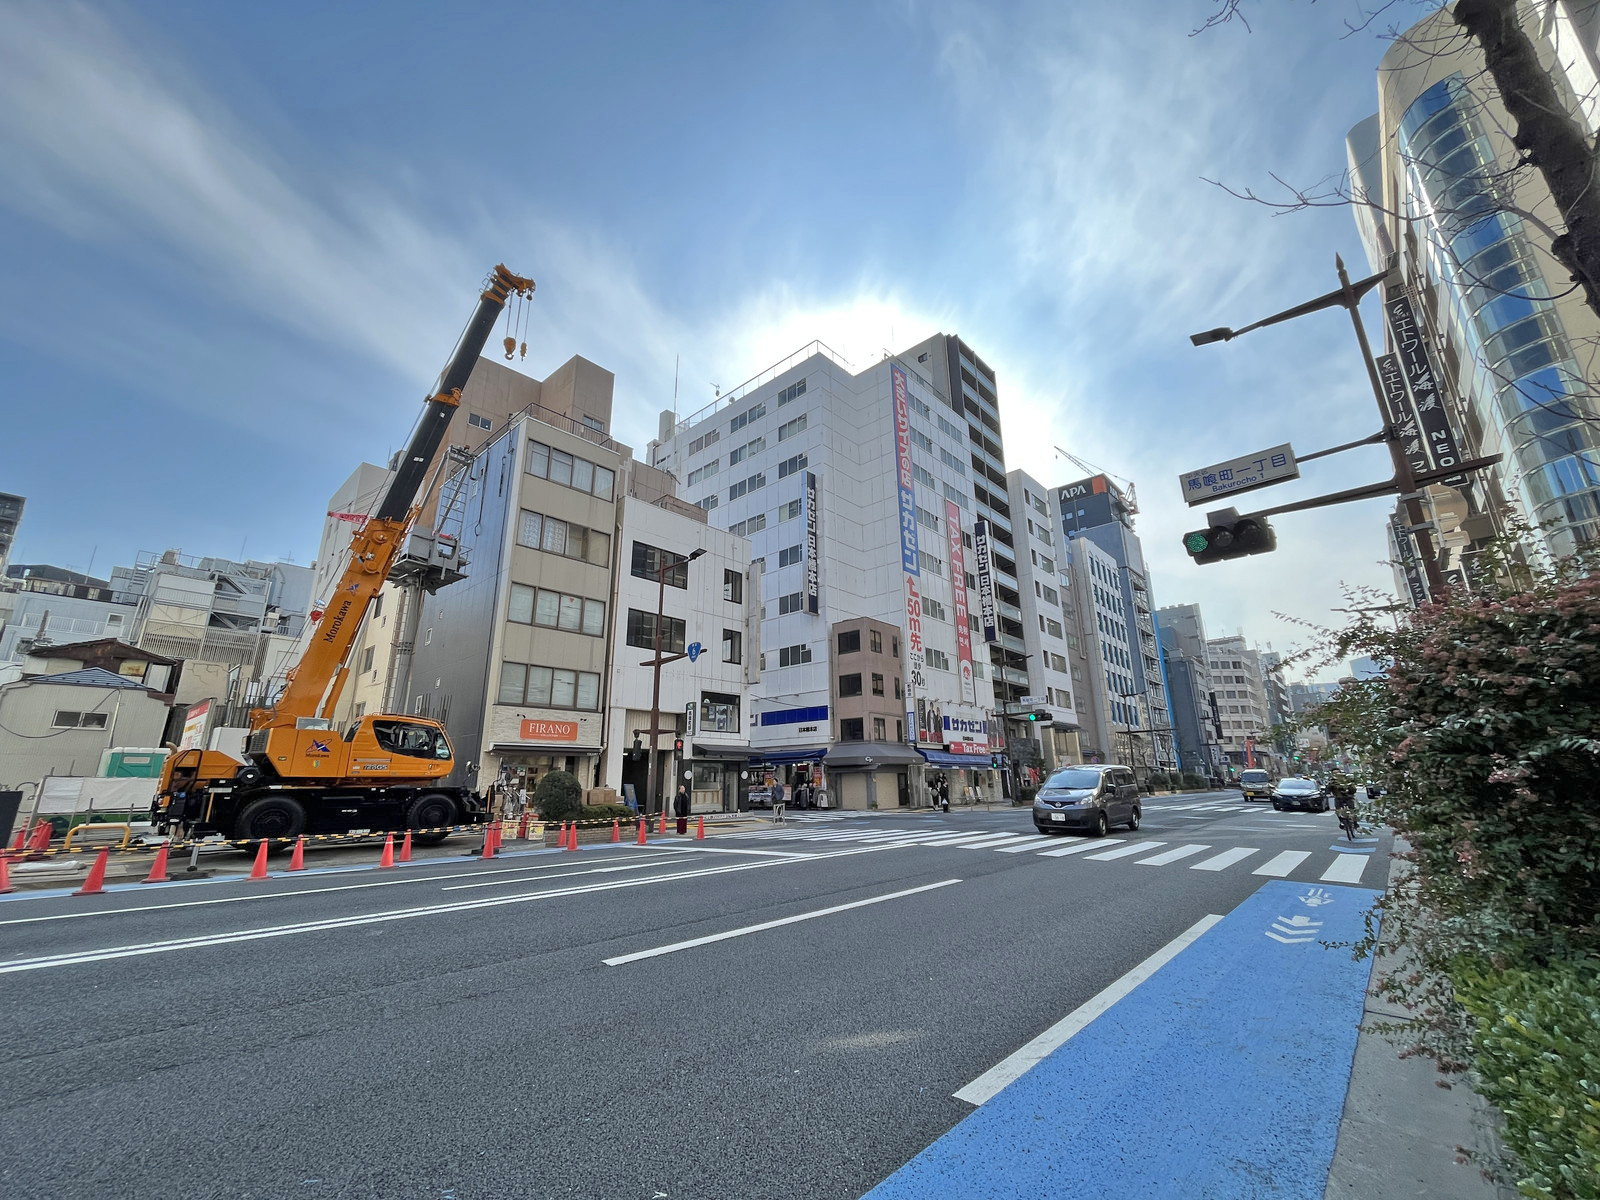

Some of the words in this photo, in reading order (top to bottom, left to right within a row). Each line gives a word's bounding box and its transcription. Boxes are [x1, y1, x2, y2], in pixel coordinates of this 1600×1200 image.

[1394, 318, 1441, 412] エトワール海渡
[1385, 371, 1425, 455] エトワール海渡
[1187, 453, 1287, 491] 馬喰町一丁目
[1212, 475, 1257, 493] Bakurocho
[1061, 484, 1087, 500] APA
[901, 490, 918, 572] サカゼン
[949, 516, 962, 557] TAX
[953, 559, 968, 618] FREE
[323, 600, 352, 643] Morokawa
[907, 598, 922, 653] 50m先
[909, 652, 925, 663] ここから
[529, 722, 571, 735] FIRANO
[951, 718, 983, 733] サカゼン
[962, 743, 973, 753] Tax
[973, 744, 986, 754] Free
